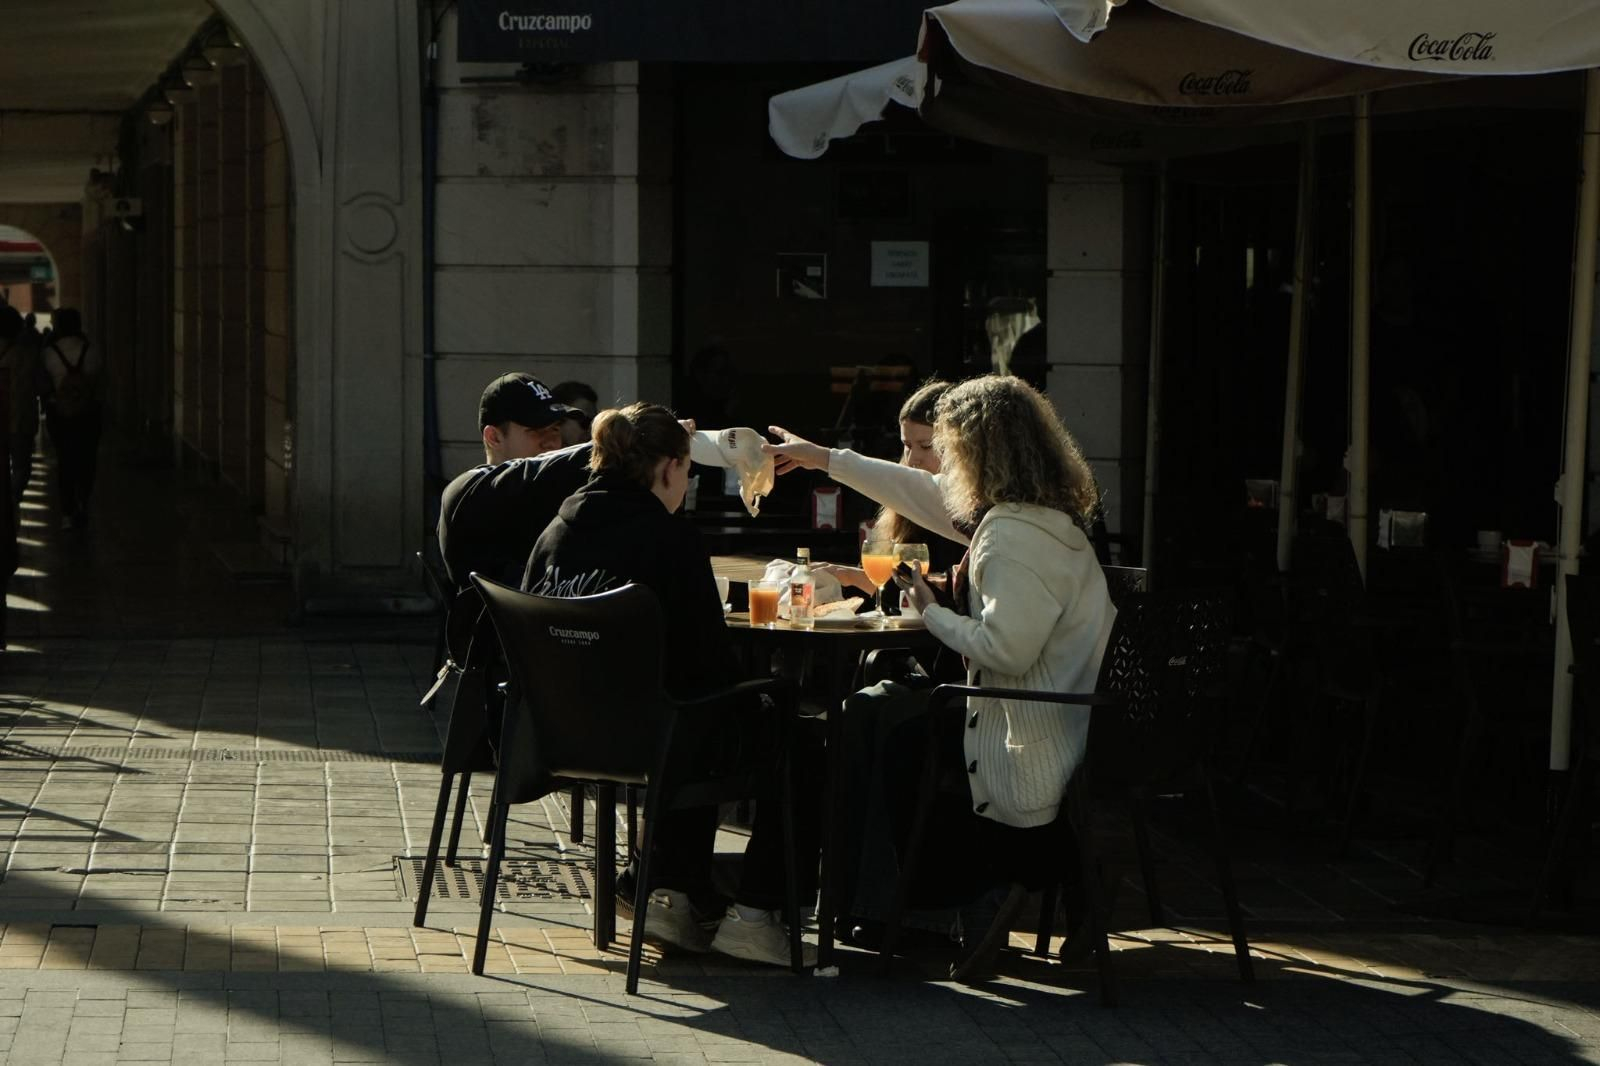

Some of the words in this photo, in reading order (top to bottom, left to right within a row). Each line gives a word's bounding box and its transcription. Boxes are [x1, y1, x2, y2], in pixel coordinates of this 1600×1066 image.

[498, 10, 592, 33] Cruzcampo
[1408, 32, 1497, 61] Coca-Cola
[1179, 69, 1254, 95] Coca-Cola
[527, 381, 552, 400] LA
[548, 625, 600, 641] Cruzcampo
